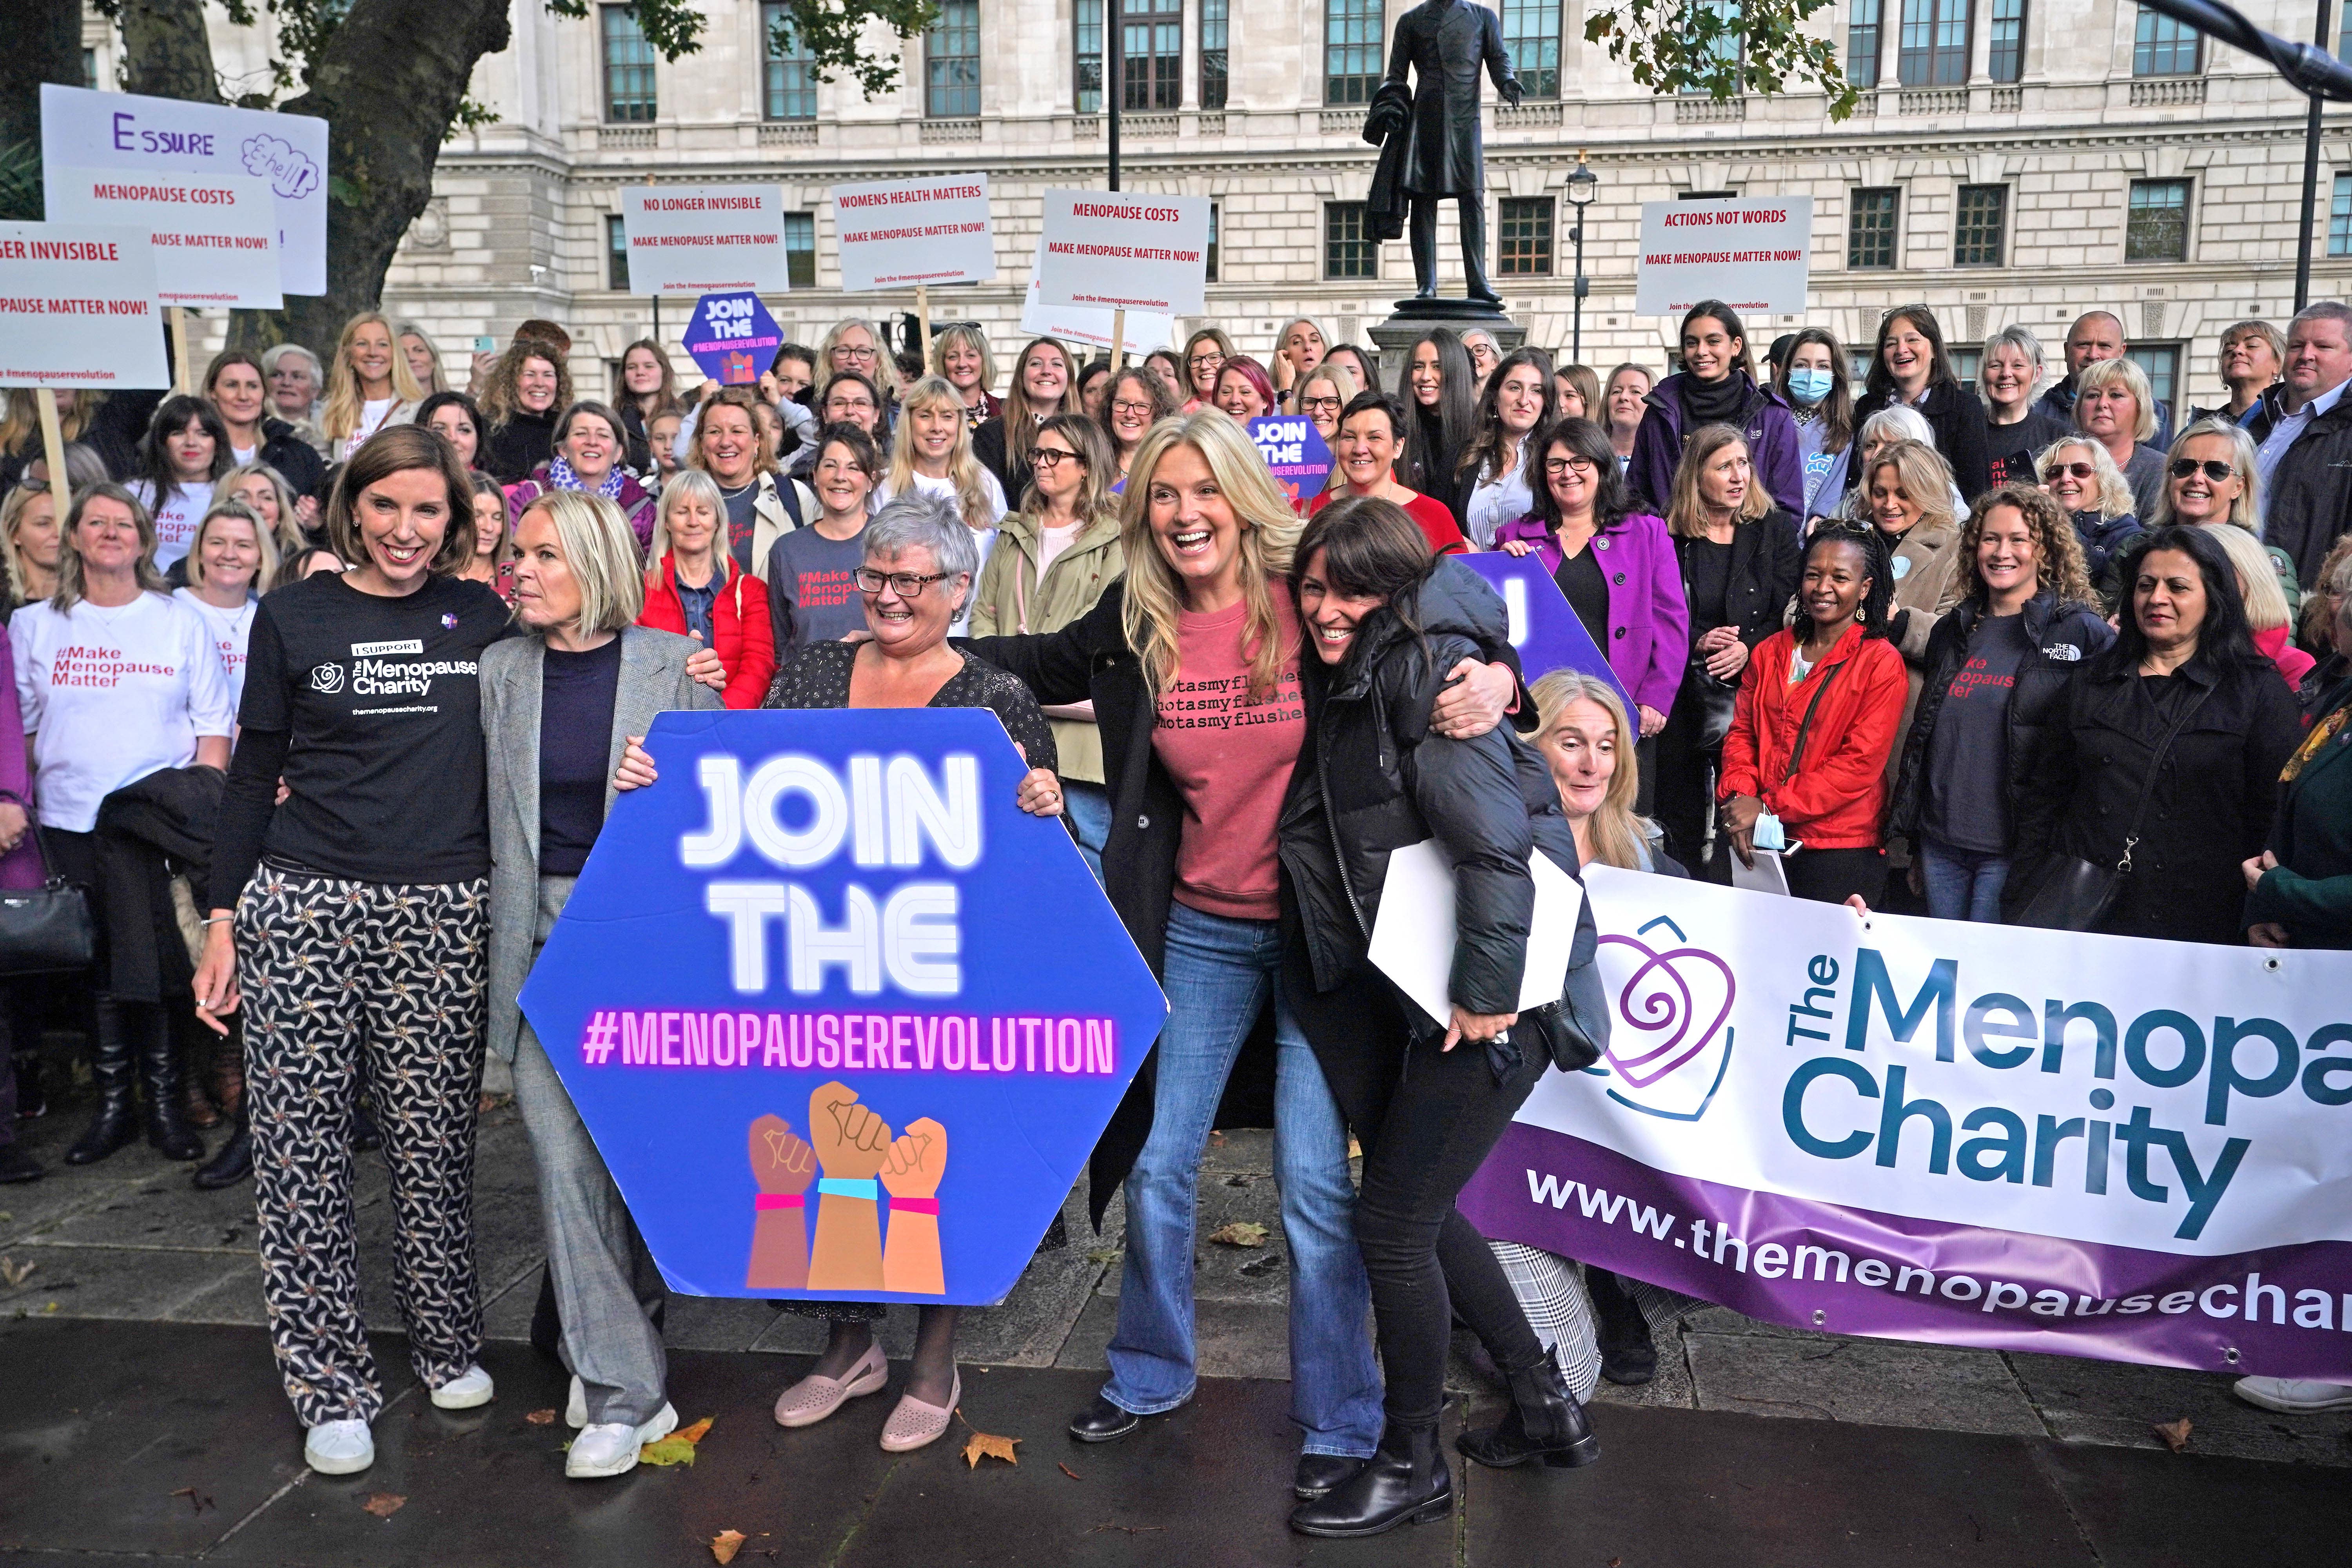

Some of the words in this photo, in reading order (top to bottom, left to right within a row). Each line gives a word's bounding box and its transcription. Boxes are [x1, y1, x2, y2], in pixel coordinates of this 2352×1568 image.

[114, 112, 214, 156] ESSURE
[94, 184, 186, 203] MENOPAUSE
[190, 189, 235, 205] COSTS
[644, 199, 660, 211] NO
[662, 198, 705, 211] LONGER
[707, 197, 761, 210] INVISIBLE
[839, 193, 888, 208] WOMENS
[890, 189, 930, 203] HEALTH
[933, 185, 981, 200] MATTERS
[1073, 203, 1142, 220] MENOPAUSE
[1144, 207, 1179, 222] COSTS
[1664, 212, 1713, 226] ACTIONS
[1716, 211, 1740, 225] NOT
[1742, 210, 1786, 223] WORDS
[633, 236, 658, 246] MAKE
[660, 235, 714, 246] MENOPAUSE
[716, 235, 751, 245] MATTER
[753, 234, 777, 244] NOW!
[844, 232, 868, 242] MAKE
[870, 227, 922, 240] MENOPAUSE
[924, 224, 959, 235] MATTER
[960, 222, 984, 232] NOW!
[31, 241, 118, 261] INVISIBLE
[185, 235, 232, 248] MATTER
[235, 237, 267, 249] NOW!
[1049, 242, 1074, 254] MAKE
[1076, 244, 1132, 258] MENOPAUSE
[1134, 248, 1171, 260] MATTER
[1173, 250, 1199, 262] NOW!
[1646, 254, 1671, 264] MAKE
[1673, 252, 1731, 264] MENOPAUSE
[1733, 251, 1771, 261] MATTER
[1774, 250, 1801, 261] NOW!
[898, 270, 964, 281] #menopauserevolution
[48, 299, 105, 314] MATTER
[108, 300, 148, 314] NOW!
[706, 298, 754, 319] JOIN
[1097, 296, 1169, 307] #menopauserevolution
[710, 318, 753, 339] THE
[693, 336, 777, 352] #MENOPAUSEREVOLUTION
[6, 370, 115, 380] #menopauserevolution
[1254, 422, 1306, 443] JOIN
[1258, 443, 1302, 463] THE
[799, 570, 849, 583] #Make
[799, 595, 849, 608] Matter
[56, 646, 121, 659] #Make
[363, 643, 418, 654] SUPPORT
[54, 660, 174, 676] Menopause
[353, 661, 361, 678] The
[362, 659, 478, 679] Menopause
[52, 673, 120, 687] Matter
[353, 677, 432, 696] Charity
[352, 705, 438, 715] themenopausecharity.org
[682, 756, 977, 865] JOIN
[708, 884, 958, 991] THE
[1786, 954, 1839, 1047] The
[584, 1011, 1114, 1074] #MENOPAUSEREVOLUTION
[1844, 948, 2352, 1126] Menopa
[1782, 1055, 2252, 1241] Charity
